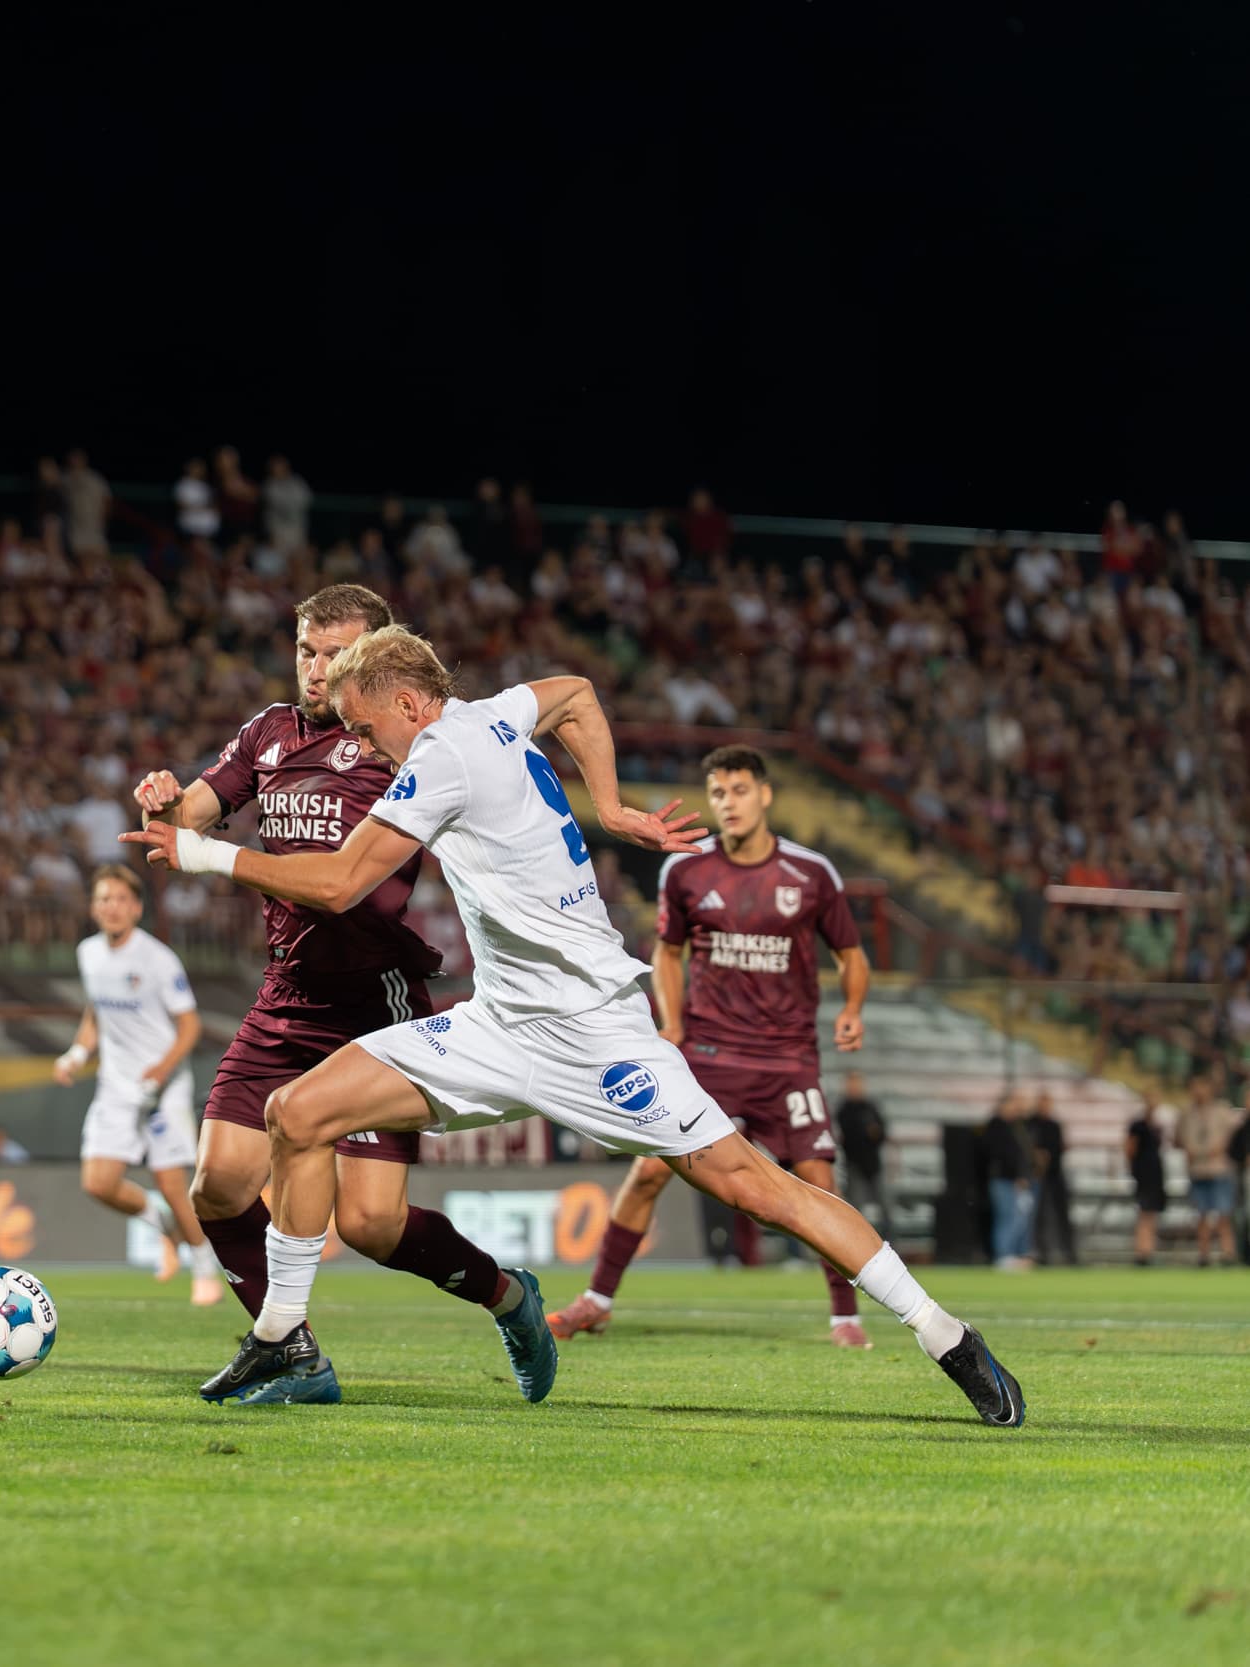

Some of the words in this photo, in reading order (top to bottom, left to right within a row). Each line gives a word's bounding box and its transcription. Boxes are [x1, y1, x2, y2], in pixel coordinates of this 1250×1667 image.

[257, 792, 342, 818] TURKISH
[524, 749, 591, 867] 9
[258, 816, 342, 842] AIRLINES
[606, 1073, 652, 1101] PEPSI
[13, 1274, 54, 1324] SELECT
